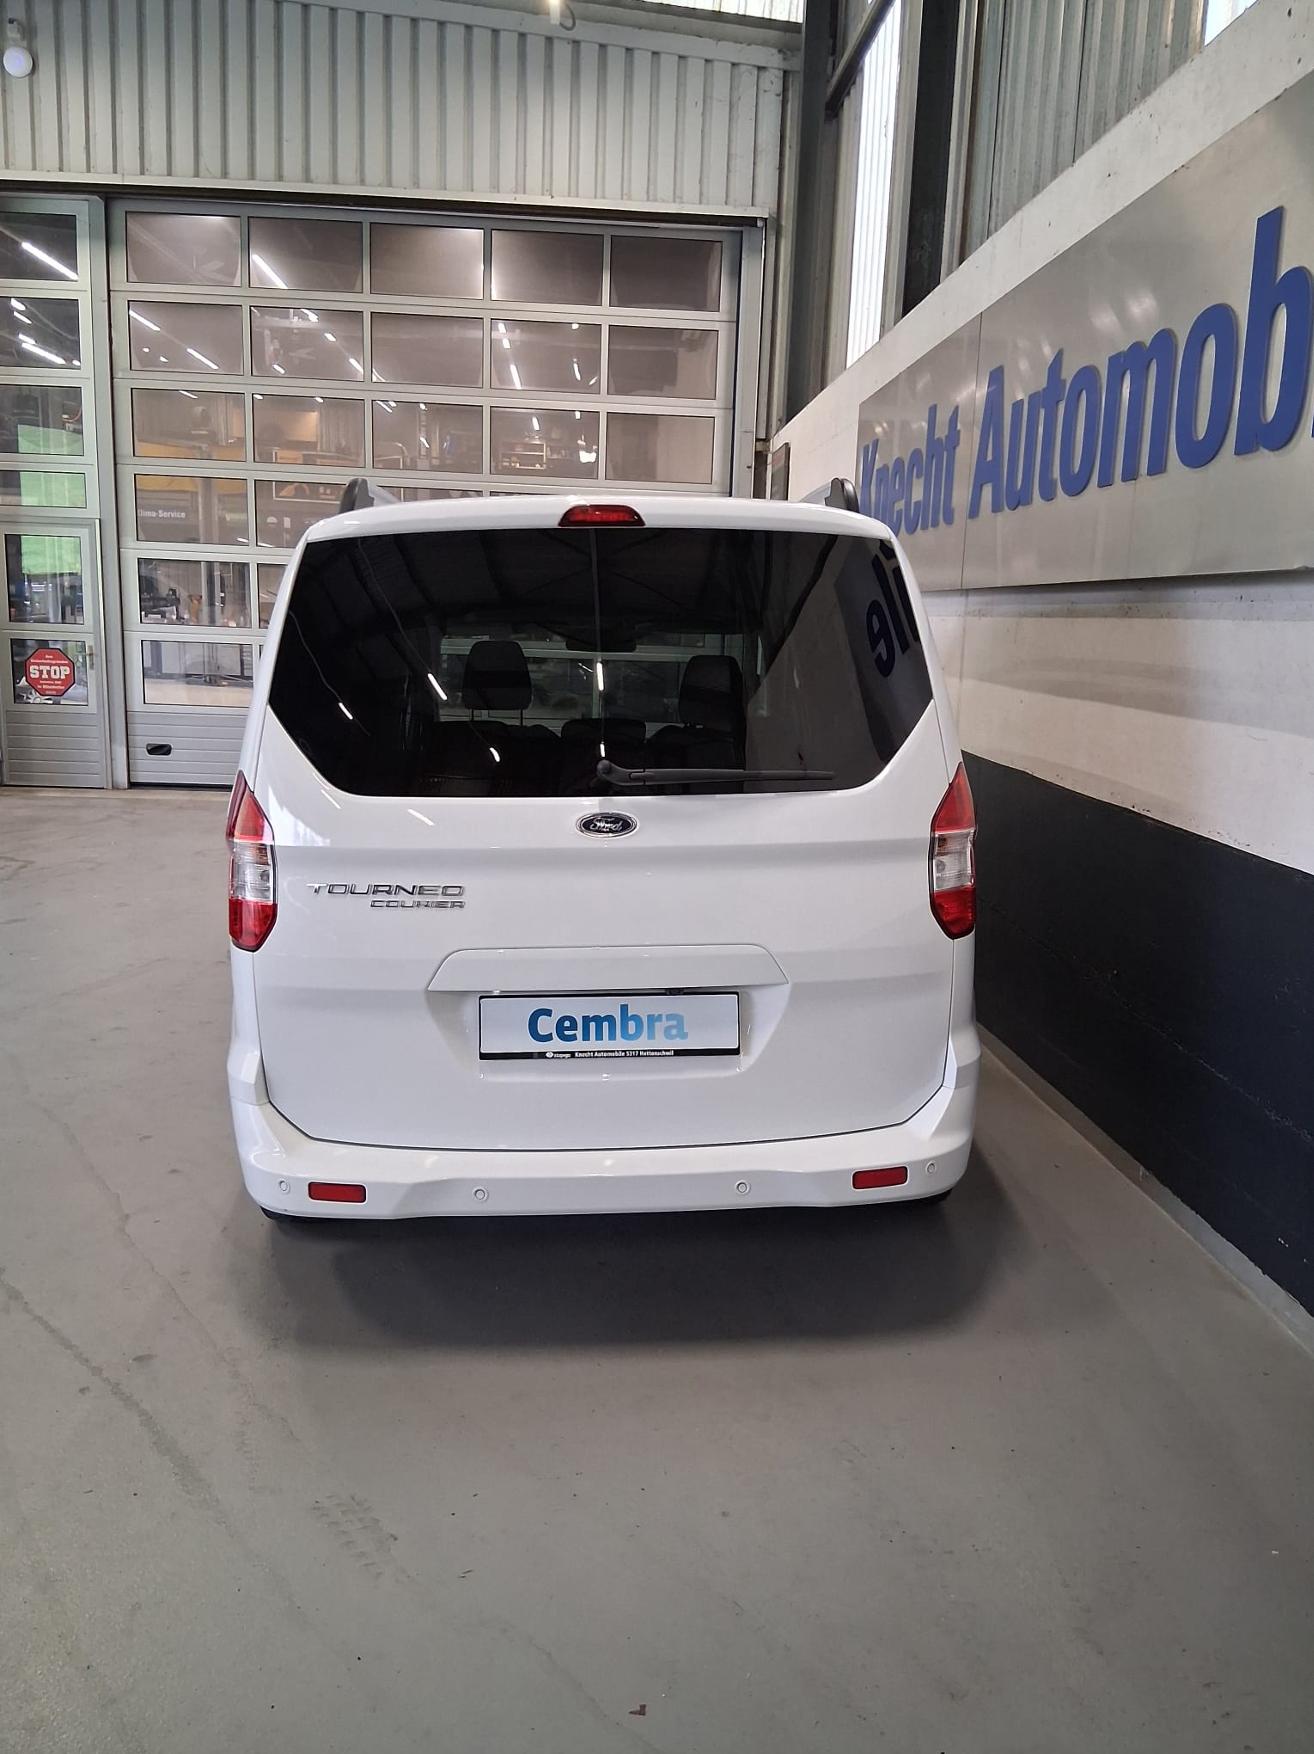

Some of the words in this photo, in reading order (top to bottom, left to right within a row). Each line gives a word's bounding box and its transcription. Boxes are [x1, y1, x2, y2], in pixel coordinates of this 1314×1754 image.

[859, 403, 961, 537] Knecht
[968, 205, 1314, 520] Automob
[30, 665, 70, 679] STOP
[590, 817, 624, 831] Ford
[306, 882, 465, 897] TOURNEO
[370, 899, 466, 909] COURIER
[527, 1003, 689, 1042] Cembra
[594, 1050, 625, 1058] Automobile
